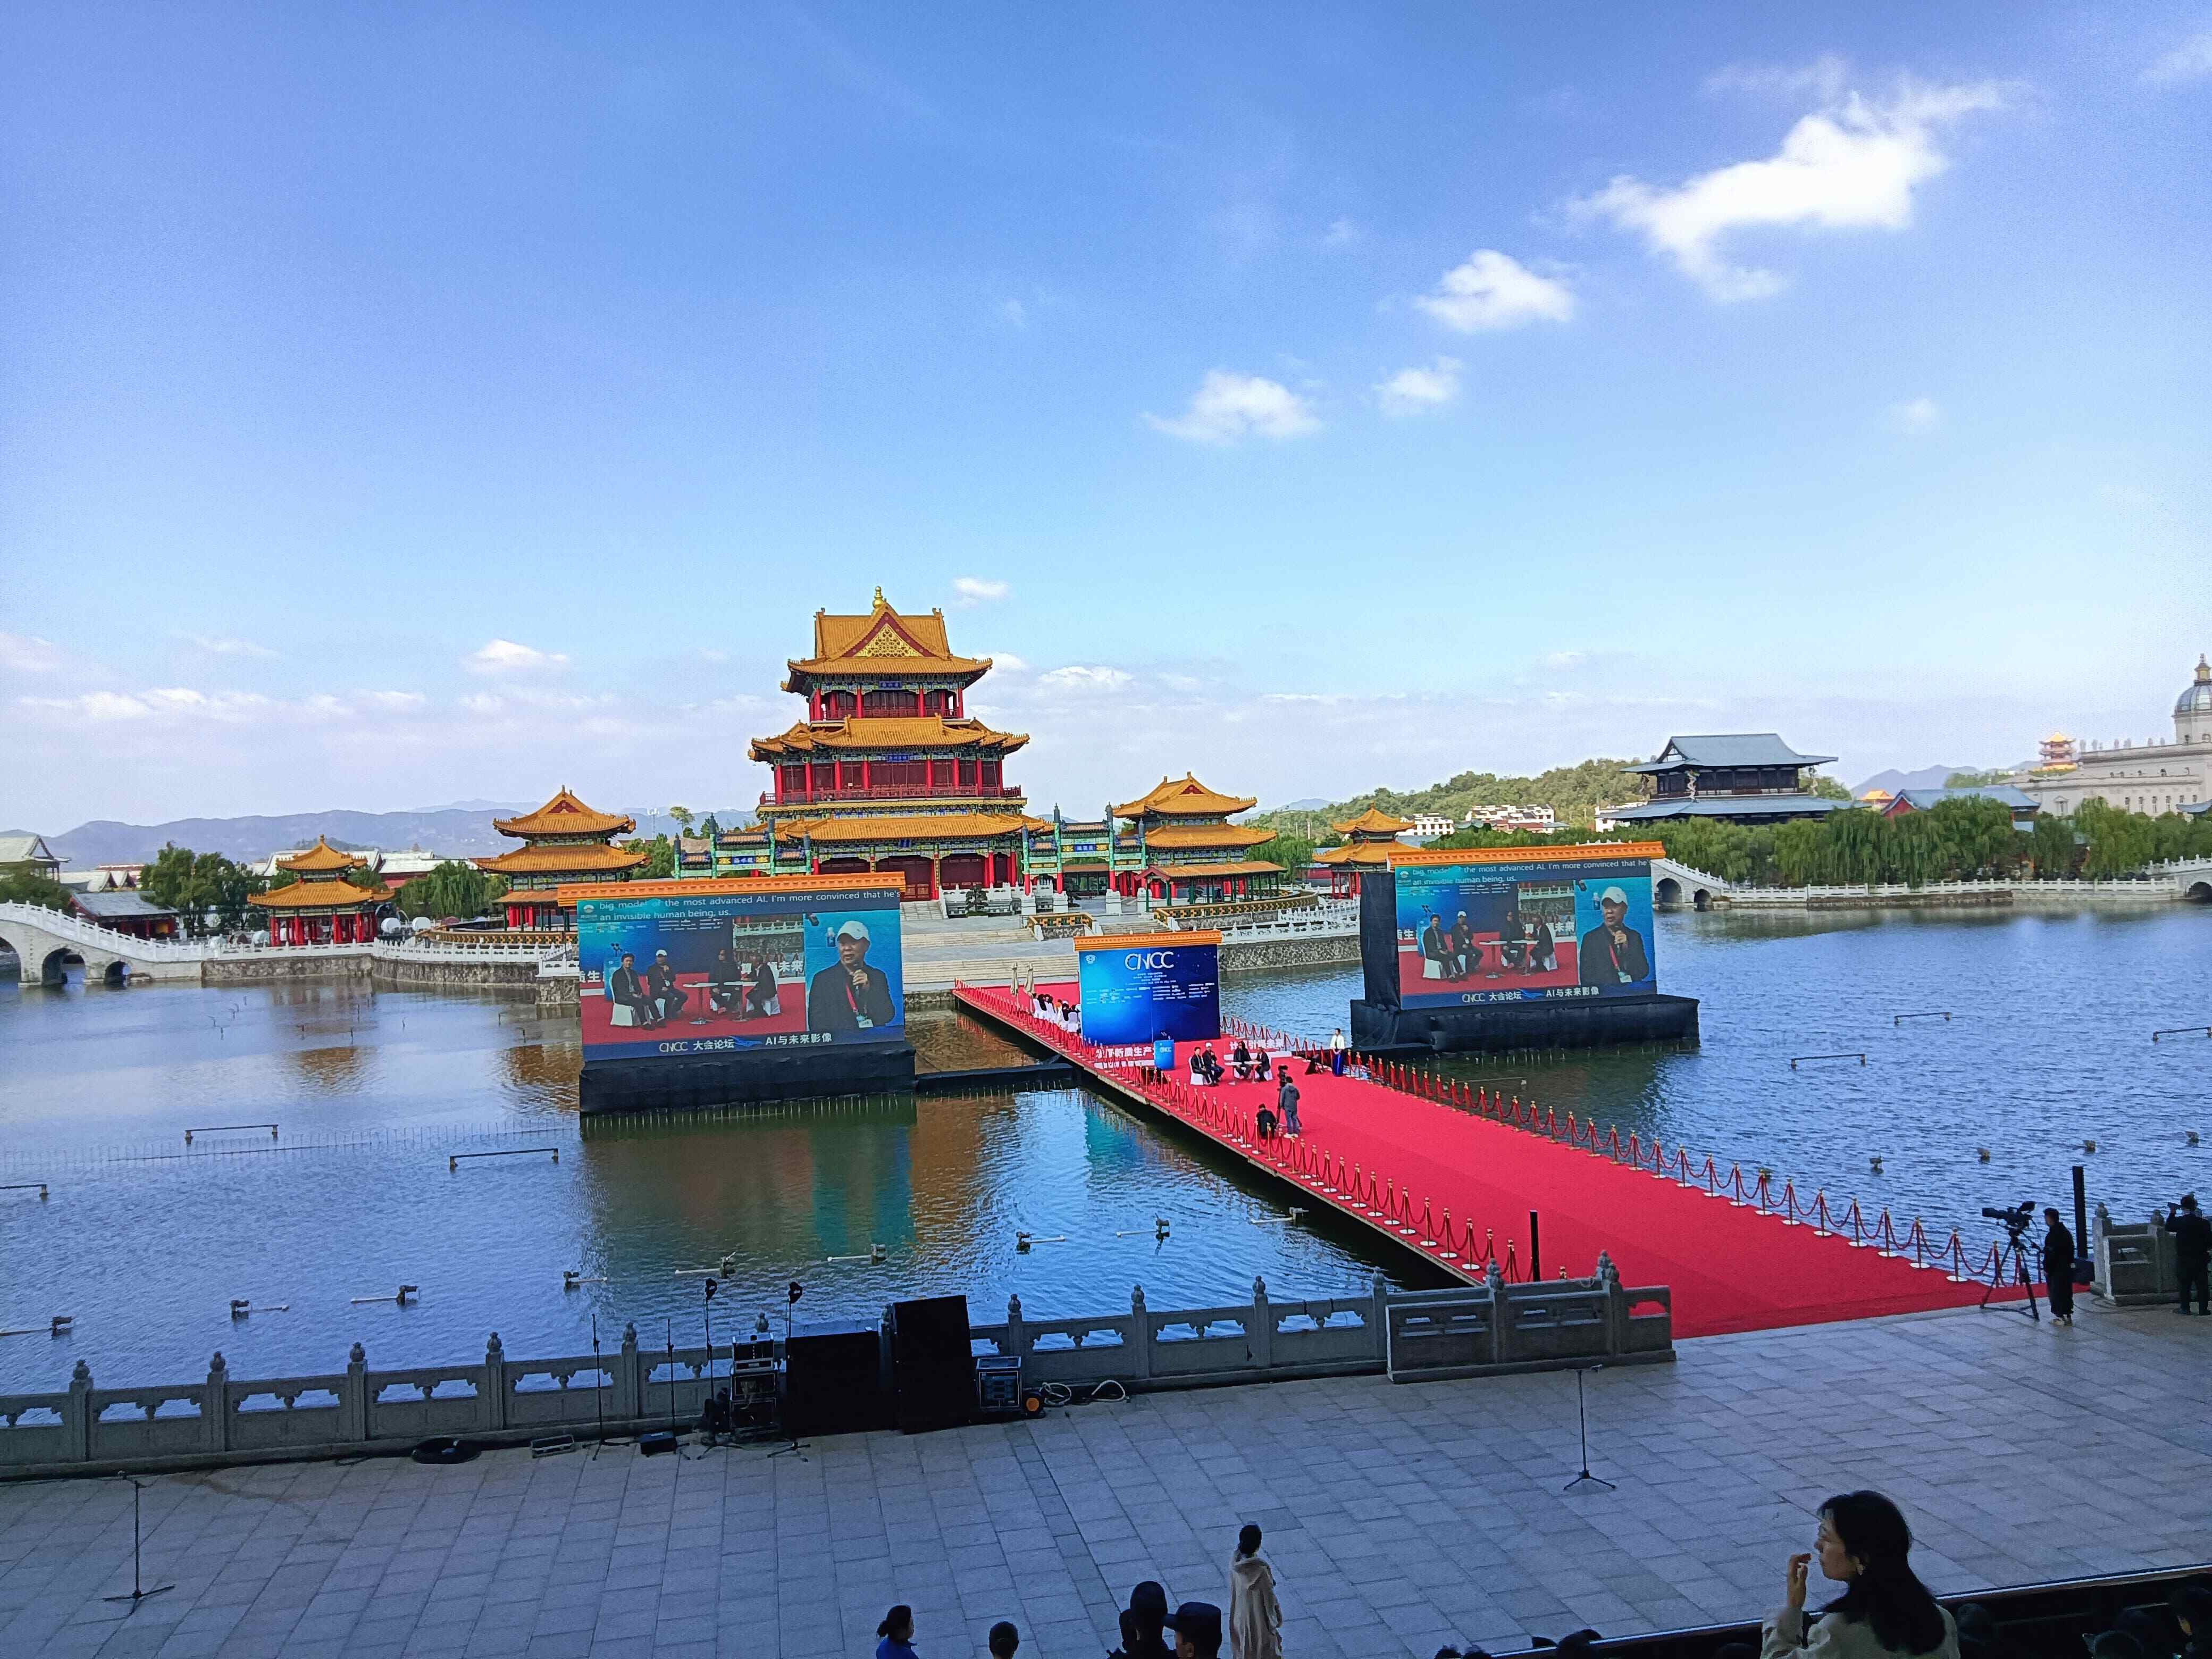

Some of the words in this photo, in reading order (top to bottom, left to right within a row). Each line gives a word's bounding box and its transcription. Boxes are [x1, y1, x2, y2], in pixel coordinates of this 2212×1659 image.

[1499, 864, 1534, 872] advanced
[1583, 860, 1619, 869] convinced
[599, 901, 614, 911] big
[665, 899, 680, 907] the
[710, 895, 752, 905] advanced
[816, 891, 859, 900] convinced
[884, 890, 900, 898] he's
[614, 911, 651, 920] invisible
[654, 910, 685, 919] human
[1125, 951, 1174, 970] CNCC
[1489, 991, 1522, 1002] 大会论坛
[1546, 986, 1599, 998] AI与未来影像
[693, 1038, 735, 1051] 大会论坛
[766, 1032, 832, 1046] AI与未来影像
